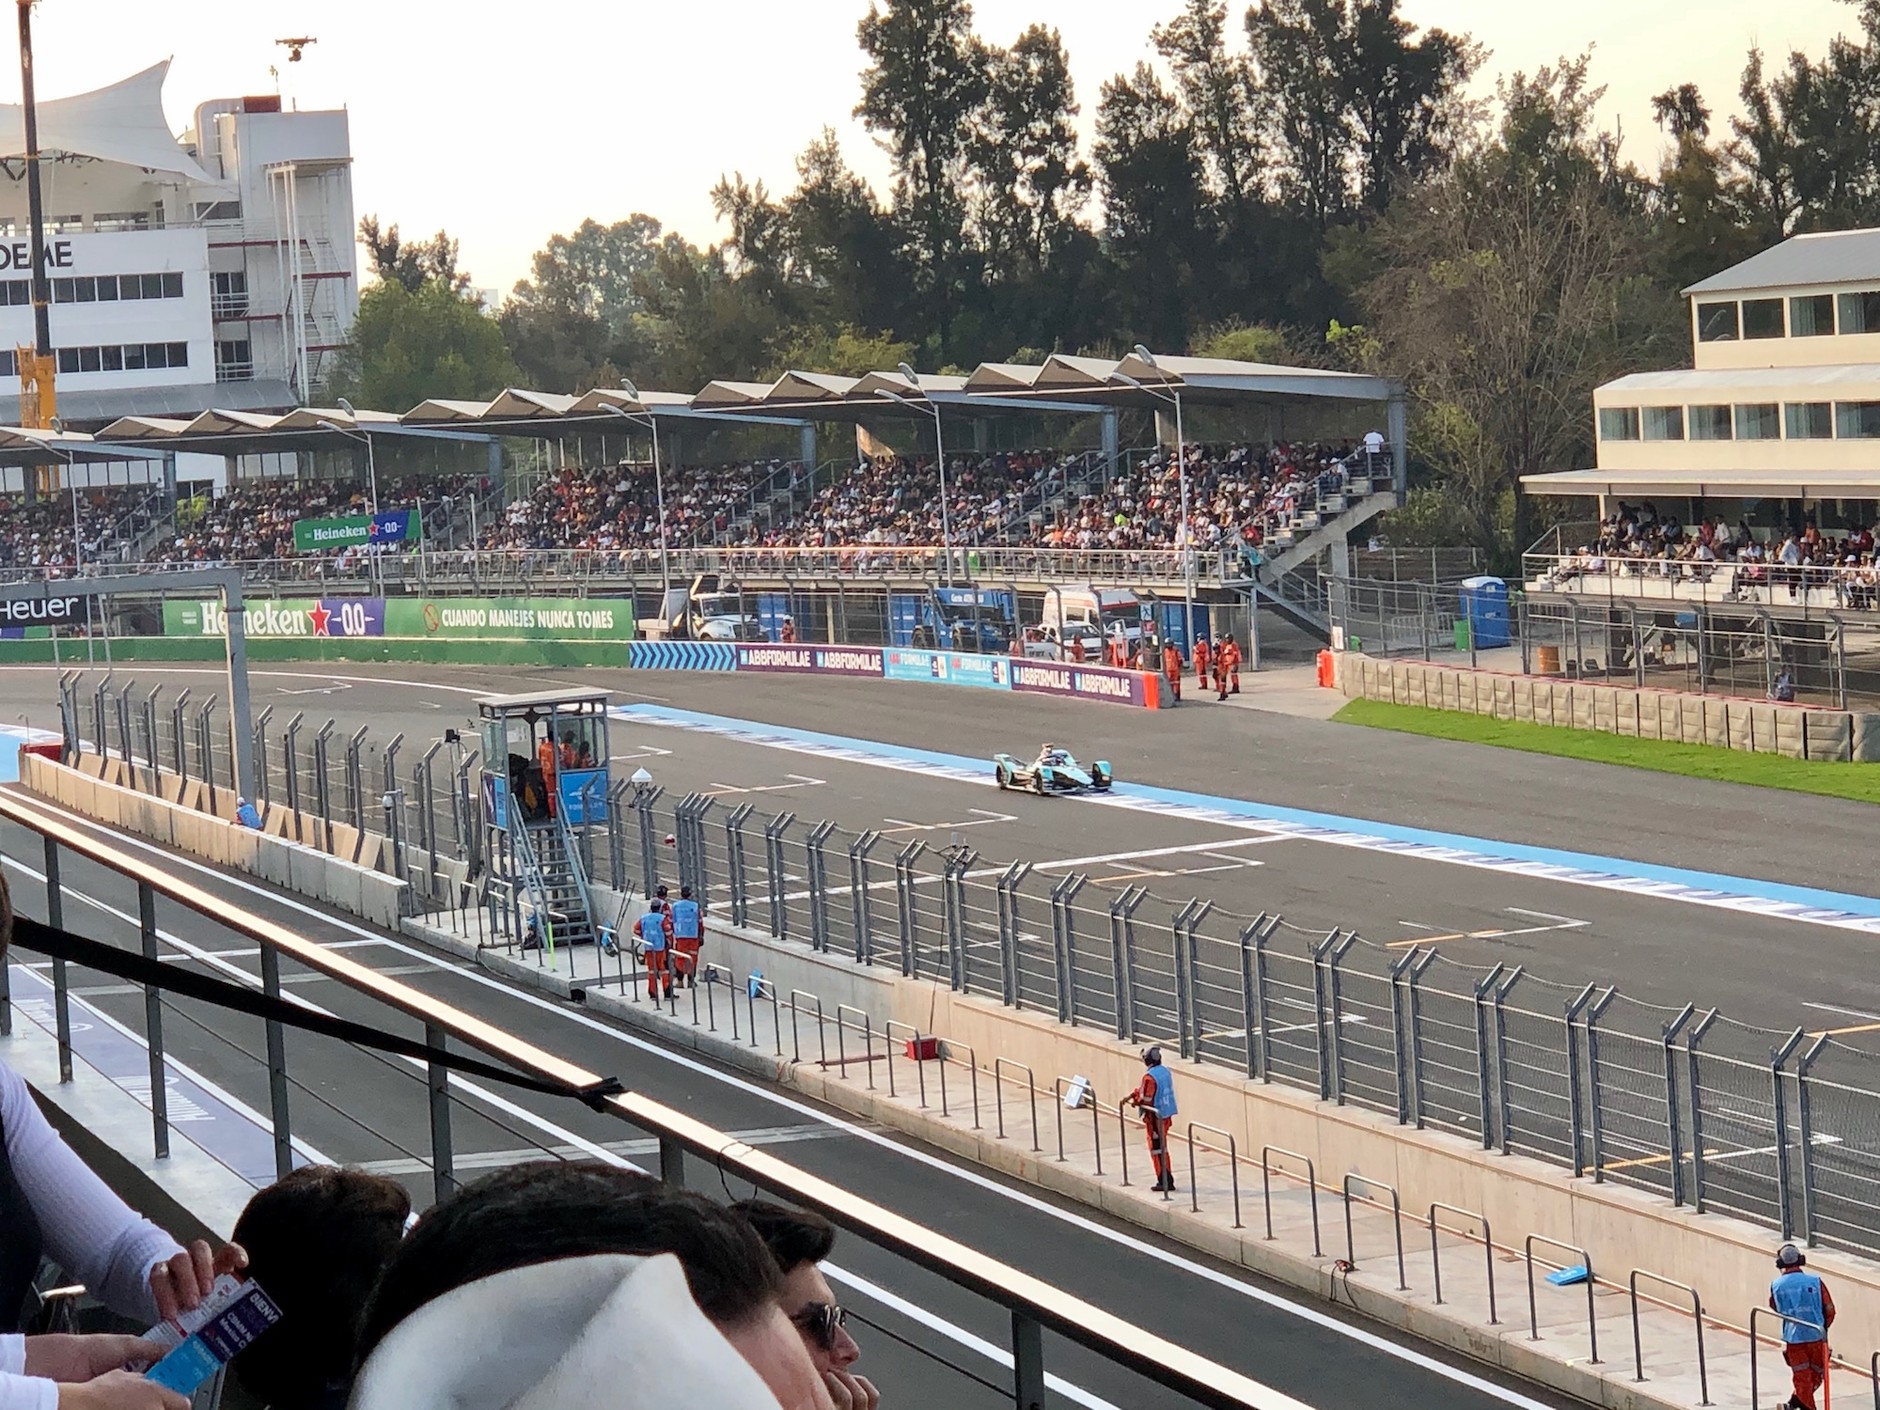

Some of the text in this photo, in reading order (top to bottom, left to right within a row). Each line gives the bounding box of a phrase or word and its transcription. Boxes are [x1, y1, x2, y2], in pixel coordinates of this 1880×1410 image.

[313, 525, 366, 541] Heineken
[200, 602, 307, 635] Heneken
[441, 609, 614, 629] CUANDO MANEJES NUNCA TOMES
